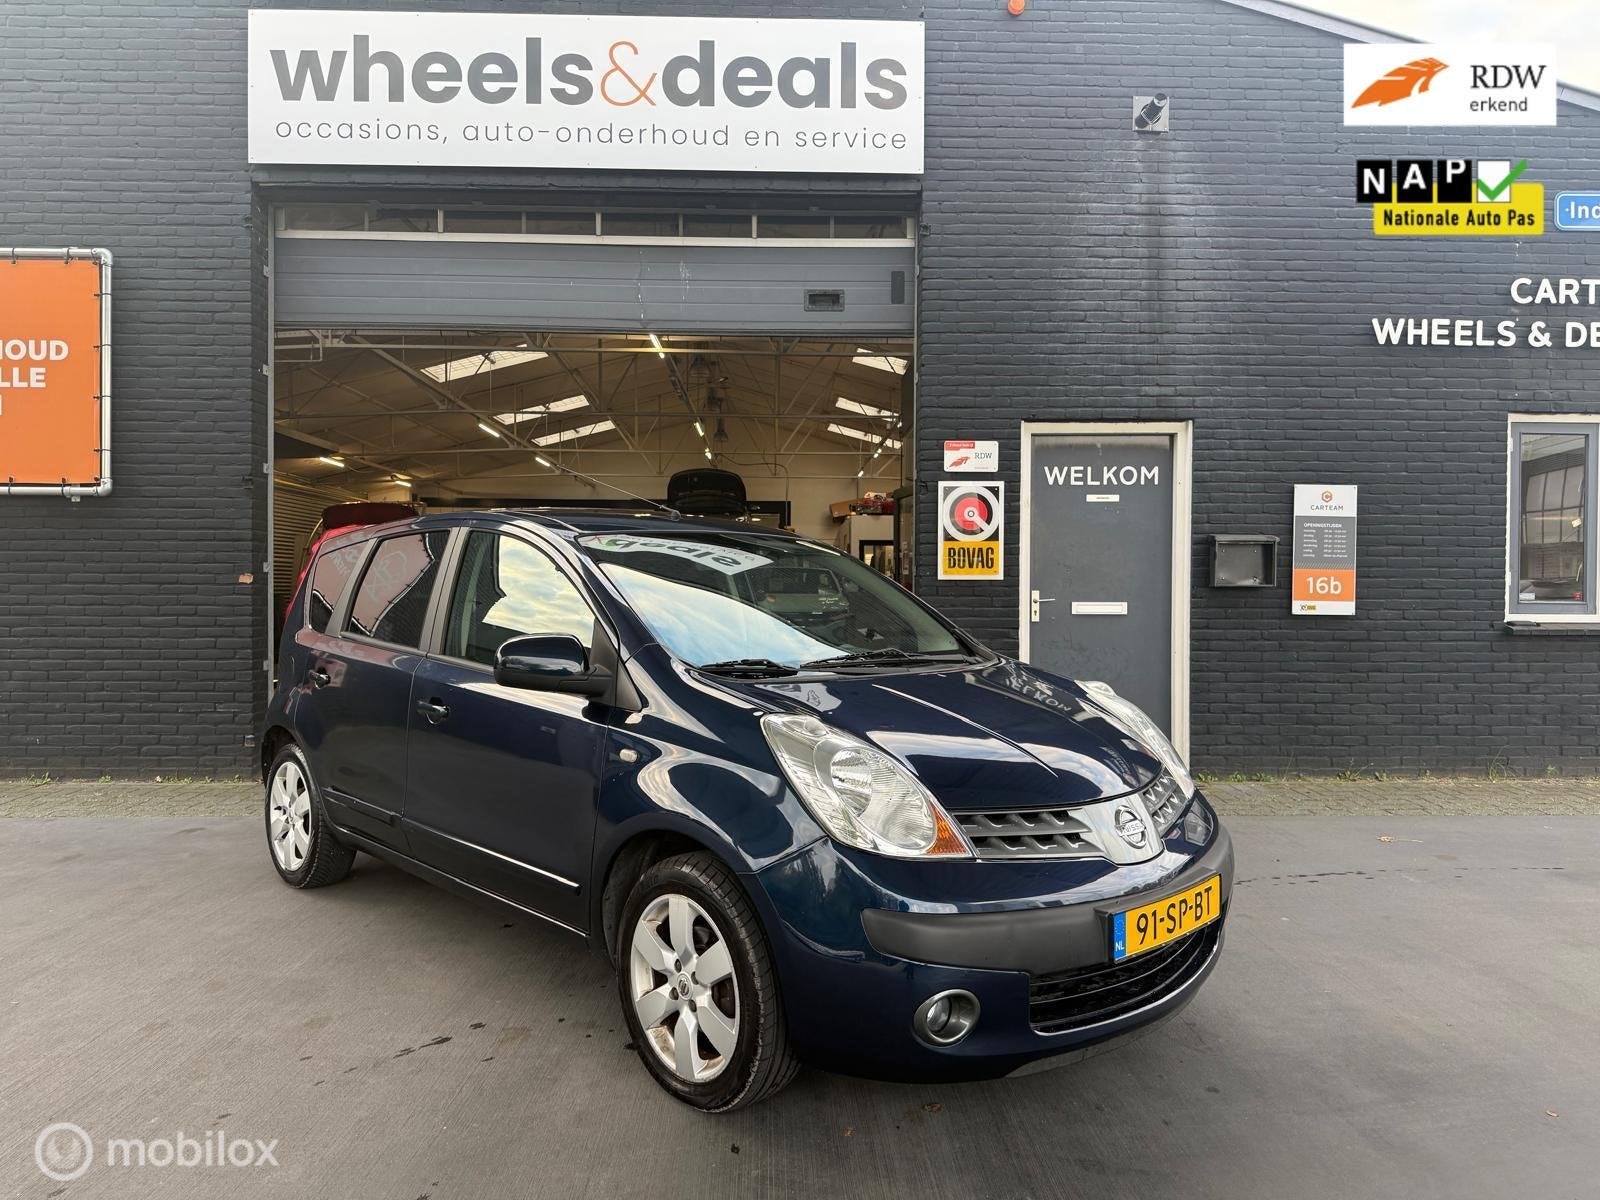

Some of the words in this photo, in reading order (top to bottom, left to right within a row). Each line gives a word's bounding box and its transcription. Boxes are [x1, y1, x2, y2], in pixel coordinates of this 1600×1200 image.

[269, 34, 908, 110] wheels&deals
[275, 117, 449, 145] occasions,
[462, 121, 730, 147] auto-onderhoud
[744, 129, 781, 148] en
[794, 127, 907, 150] service
[1510, 277, 1600, 305] CART
[1371, 317, 1517, 347] WHEELS
[1527, 320, 1553, 348] &
[0, 338, 69, 361] OUD
[1043, 465, 1159, 486] WELKOM
[947, 546, 995, 569] BOVAG
[1306, 576, 1342, 595] 16b
[1136, 886, 1213, 945] 91-SP-BT
[1115, 940, 1125, 952] NL
